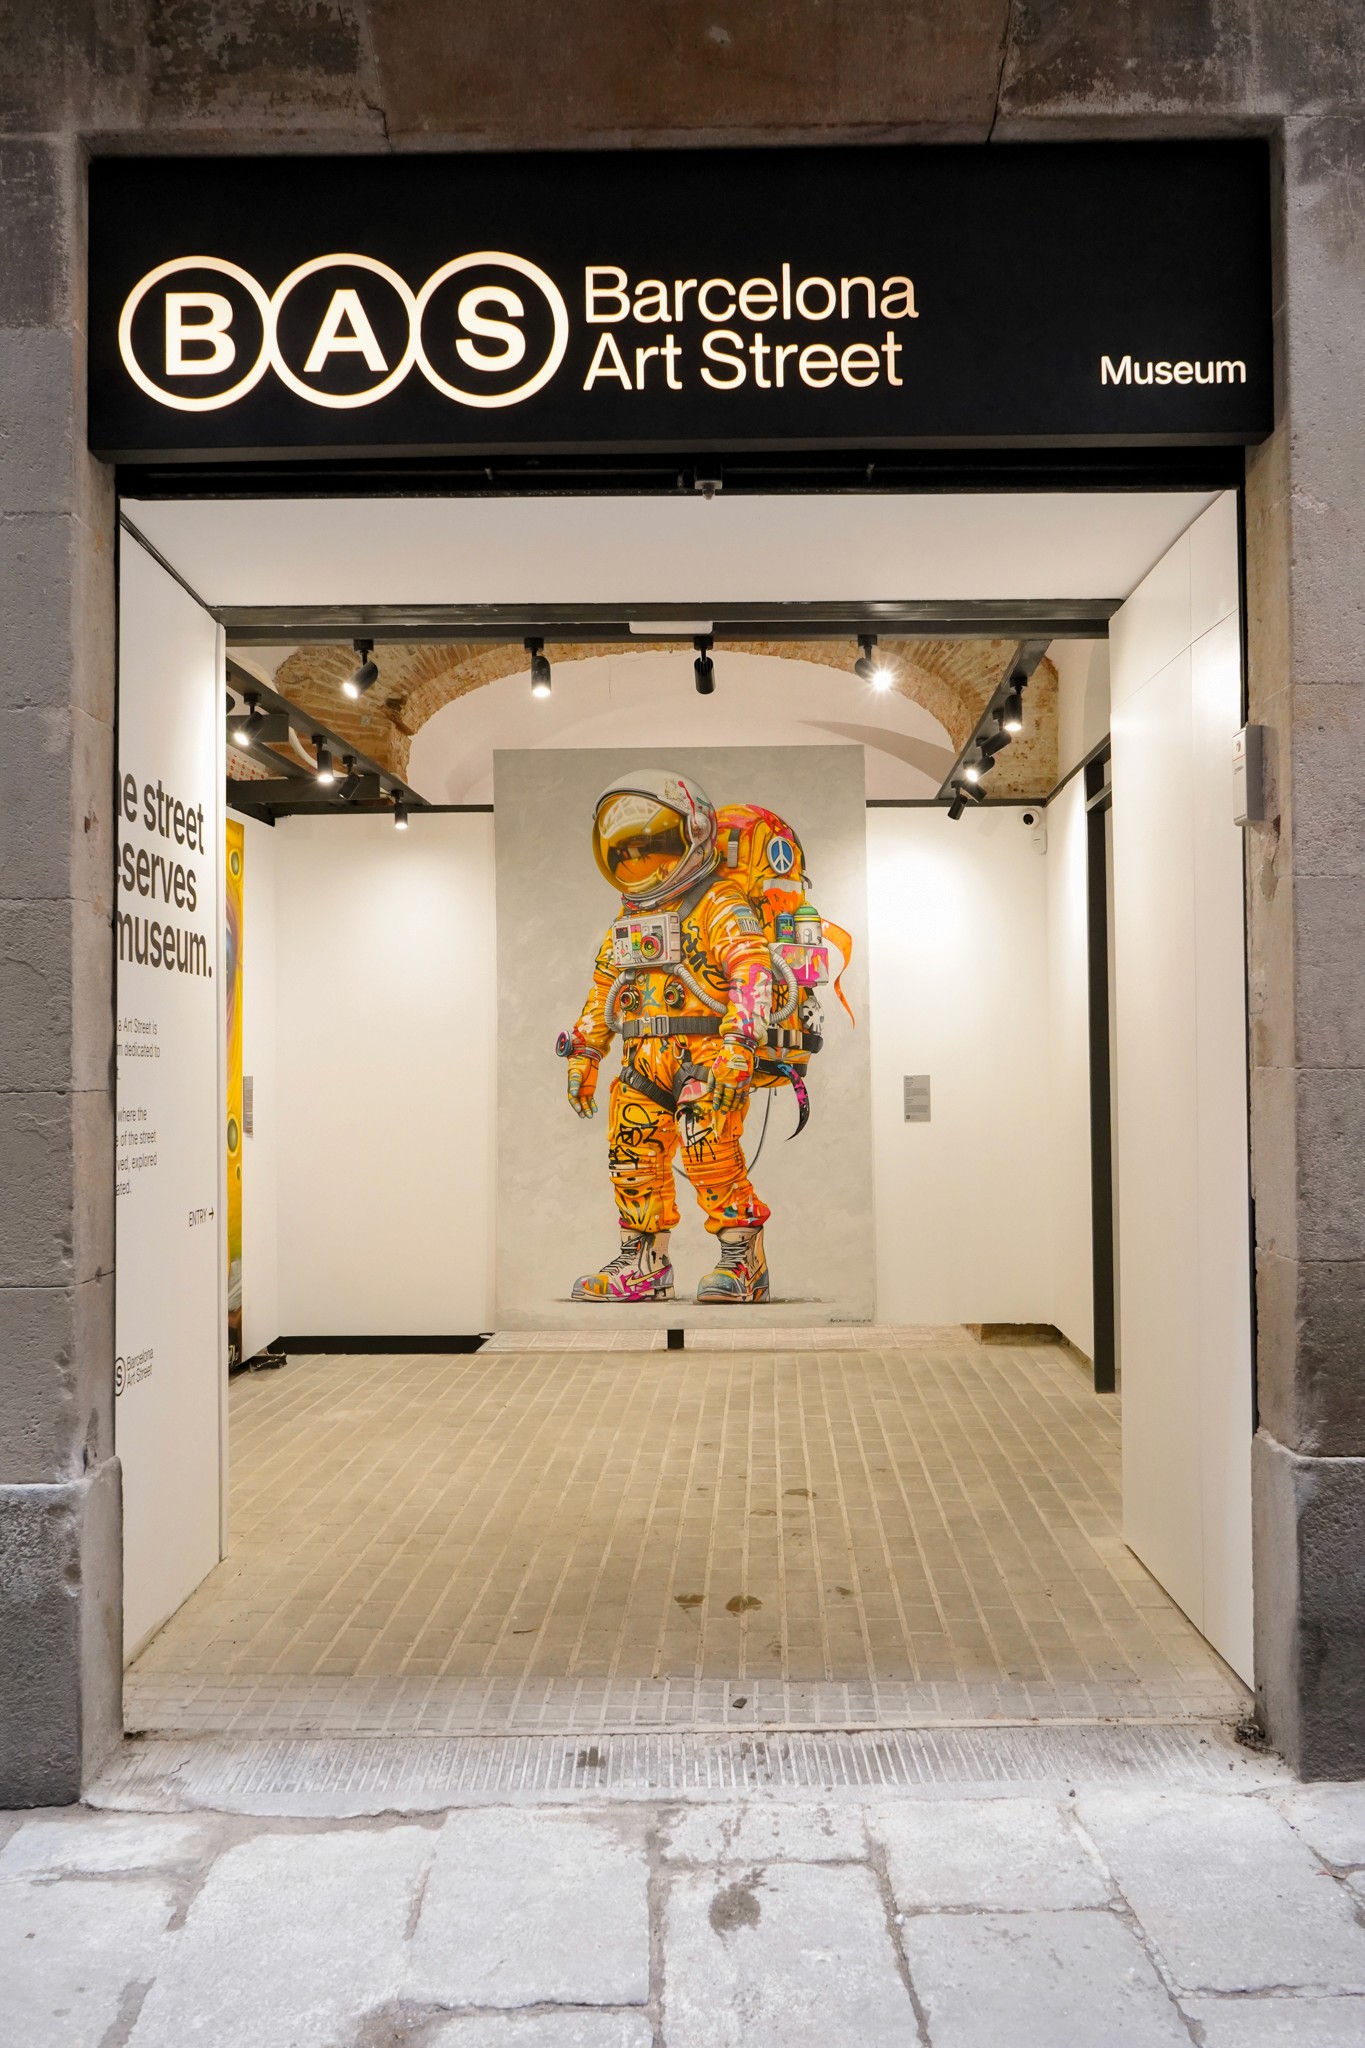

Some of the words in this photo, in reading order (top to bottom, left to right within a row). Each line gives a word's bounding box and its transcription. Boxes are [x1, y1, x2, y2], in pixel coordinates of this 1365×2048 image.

[585, 262, 920, 324] Barcelona
[582, 332, 683, 391] Art
[700, 329, 904, 390] Street
[1100, 354, 1247, 386] Museum
[143, 779, 204, 855] street
[123, 1017, 133, 1033] Art
[134, 1018, 151, 1035] Street
[152, 1019, 158, 1035] is
[124, 1041, 154, 1058] dedicated
[154, 1044, 160, 1058] to
[137, 1106, 147, 1121] the
[120, 1130, 127, 1147] of
[128, 1130, 138, 1146] the
[139, 1129, 157, 1145] street
[131, 1151, 157, 1172] explored
[188, 1207, 208, 1227] ENTRY
[127, 1348, 154, 1372] Barcelona
[136, 1363, 153, 1383] Street
